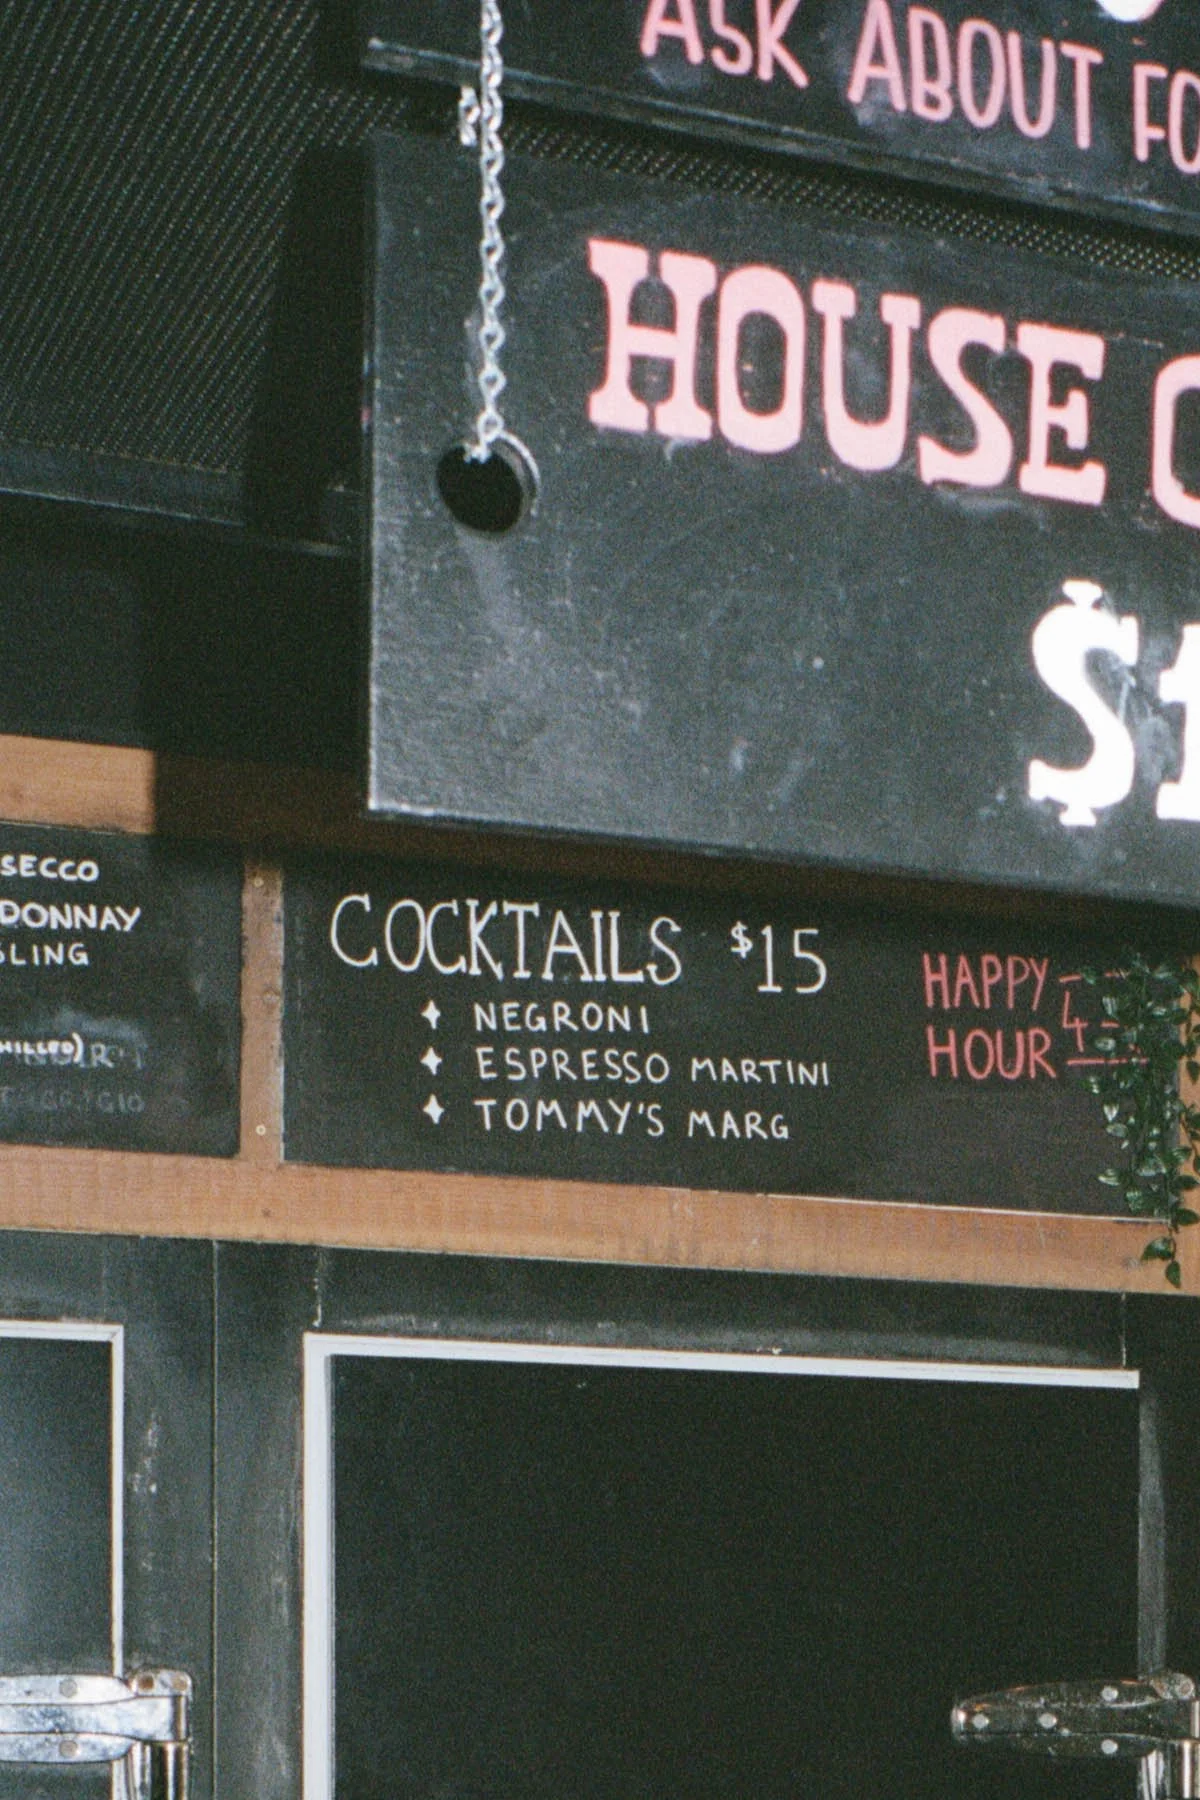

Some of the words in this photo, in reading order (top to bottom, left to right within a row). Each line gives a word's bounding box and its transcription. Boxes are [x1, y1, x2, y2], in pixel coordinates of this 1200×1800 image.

[640, 0, 808, 88] ASK
[848, 0, 1103, 150] ABOUT
[588, 238, 1106, 505] HOUSE
[329, 893, 682, 986] COCKTAILS
[730, 921, 828, 994] $15
[922, 953, 1048, 1011] HAPPY
[473, 1001, 649, 1034] NEGRONI
[474, 1046, 671, 1083] ESPRESSO
[690, 1057, 830, 1087] MARTINI
[926, 1025, 1057, 1080] HOUR
[474, 1098, 665, 1137] TOMMY'S
[687, 1109, 789, 1140] MARG
